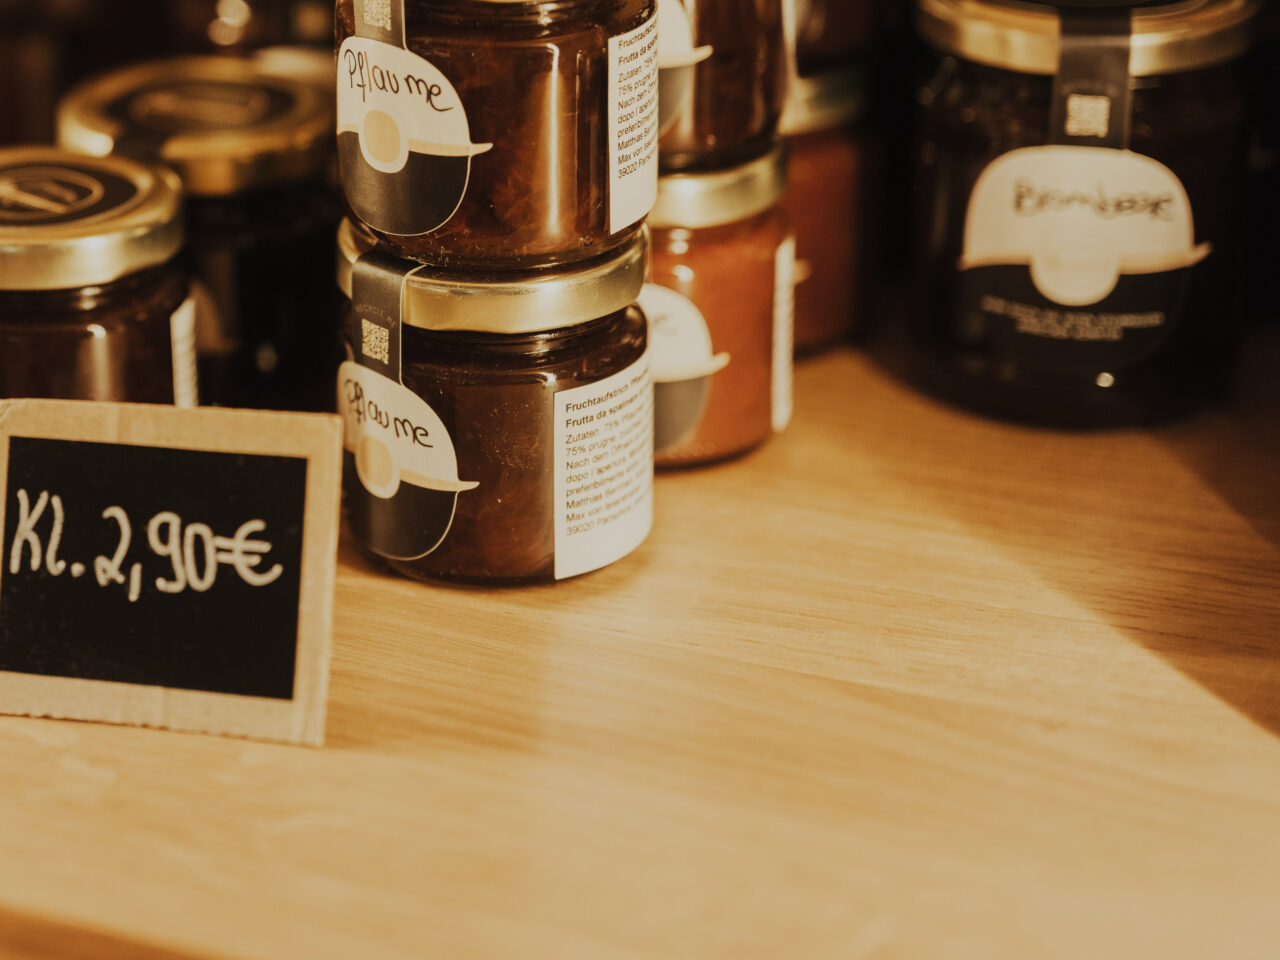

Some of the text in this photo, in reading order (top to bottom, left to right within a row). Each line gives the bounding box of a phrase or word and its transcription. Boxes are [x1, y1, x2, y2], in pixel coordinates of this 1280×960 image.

[344, 48, 454, 113] Pflaume
[344, 379, 434, 448] Pflaume
[565, 415, 594, 428] Frutta
[94, 505, 283, 602] 2,90€
